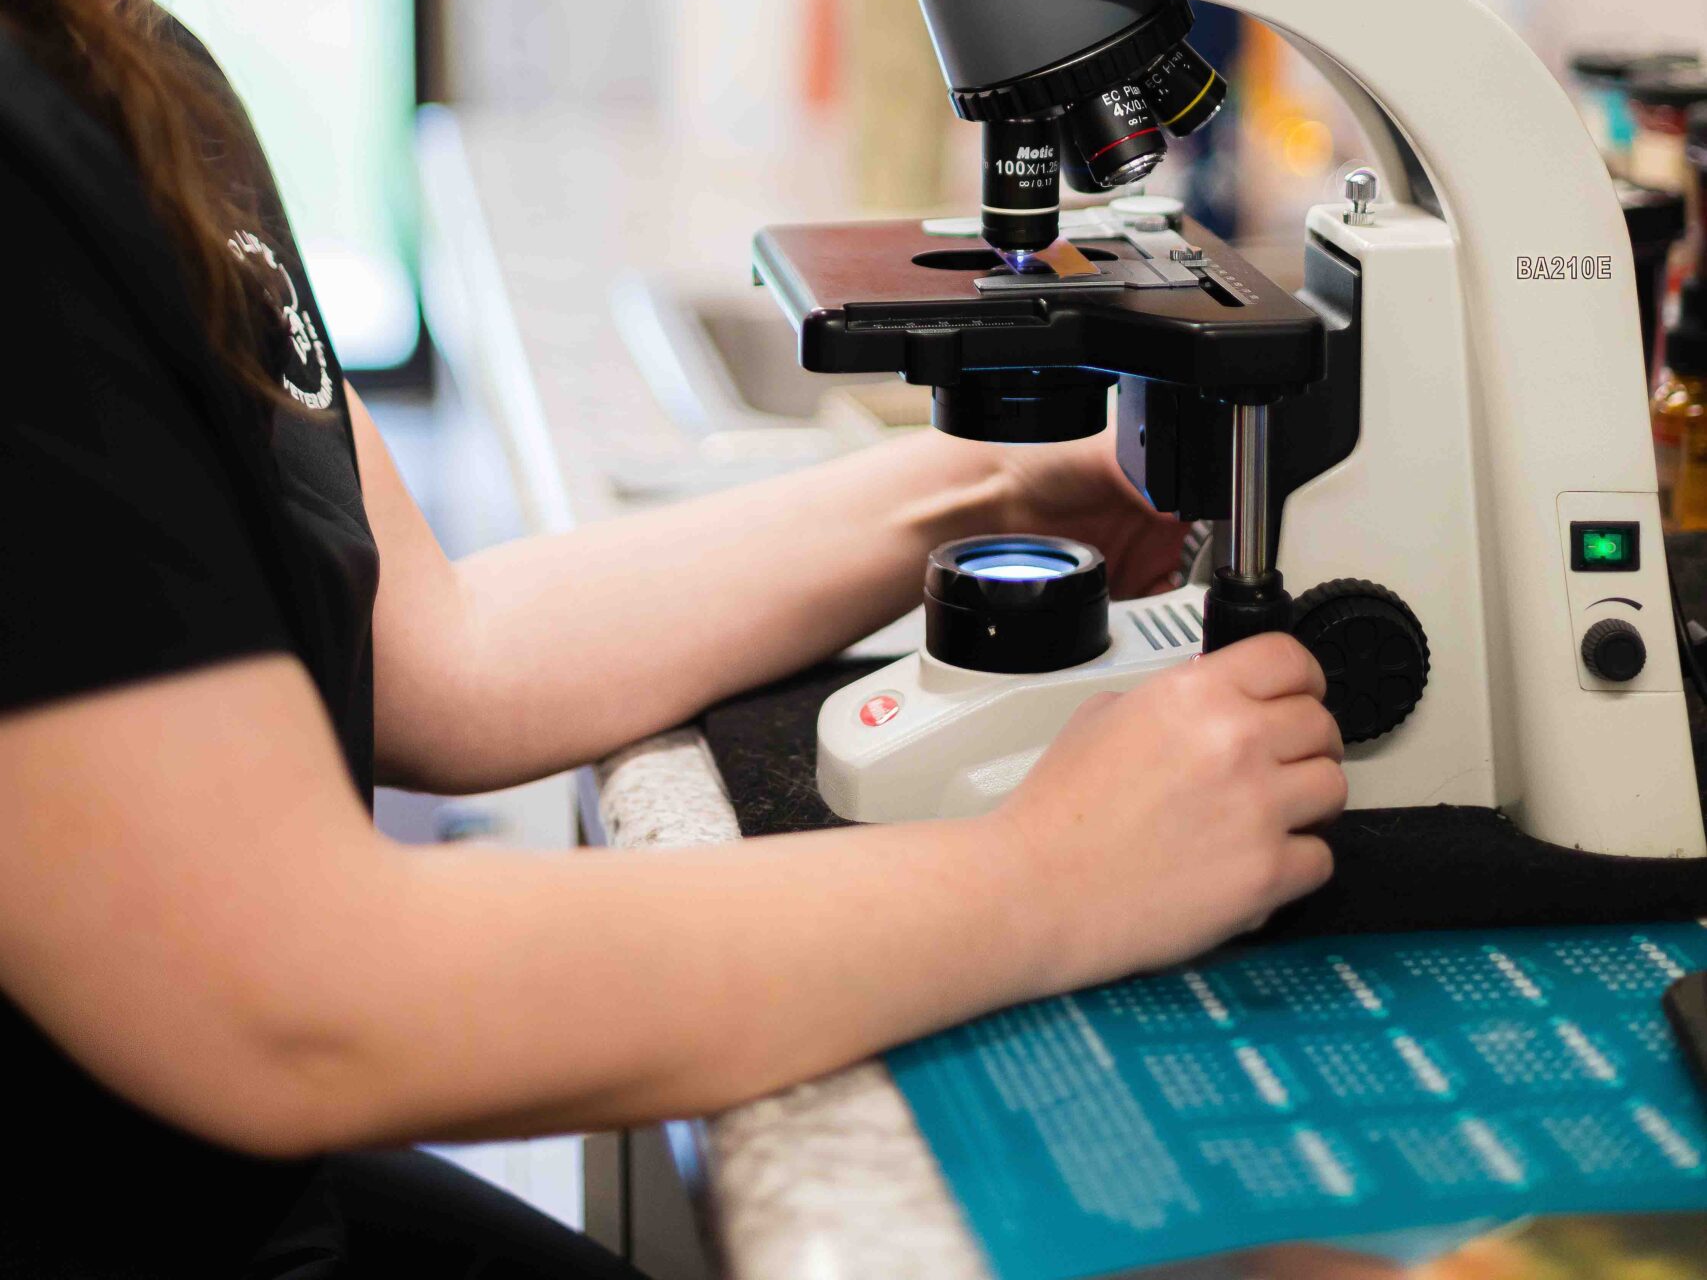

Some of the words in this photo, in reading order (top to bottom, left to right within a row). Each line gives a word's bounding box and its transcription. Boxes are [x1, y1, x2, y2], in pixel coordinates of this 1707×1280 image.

[1101, 90, 1121, 106] EC
[1016, 145, 1054, 160] Motic
[1516, 255, 1611, 280] BA210E
